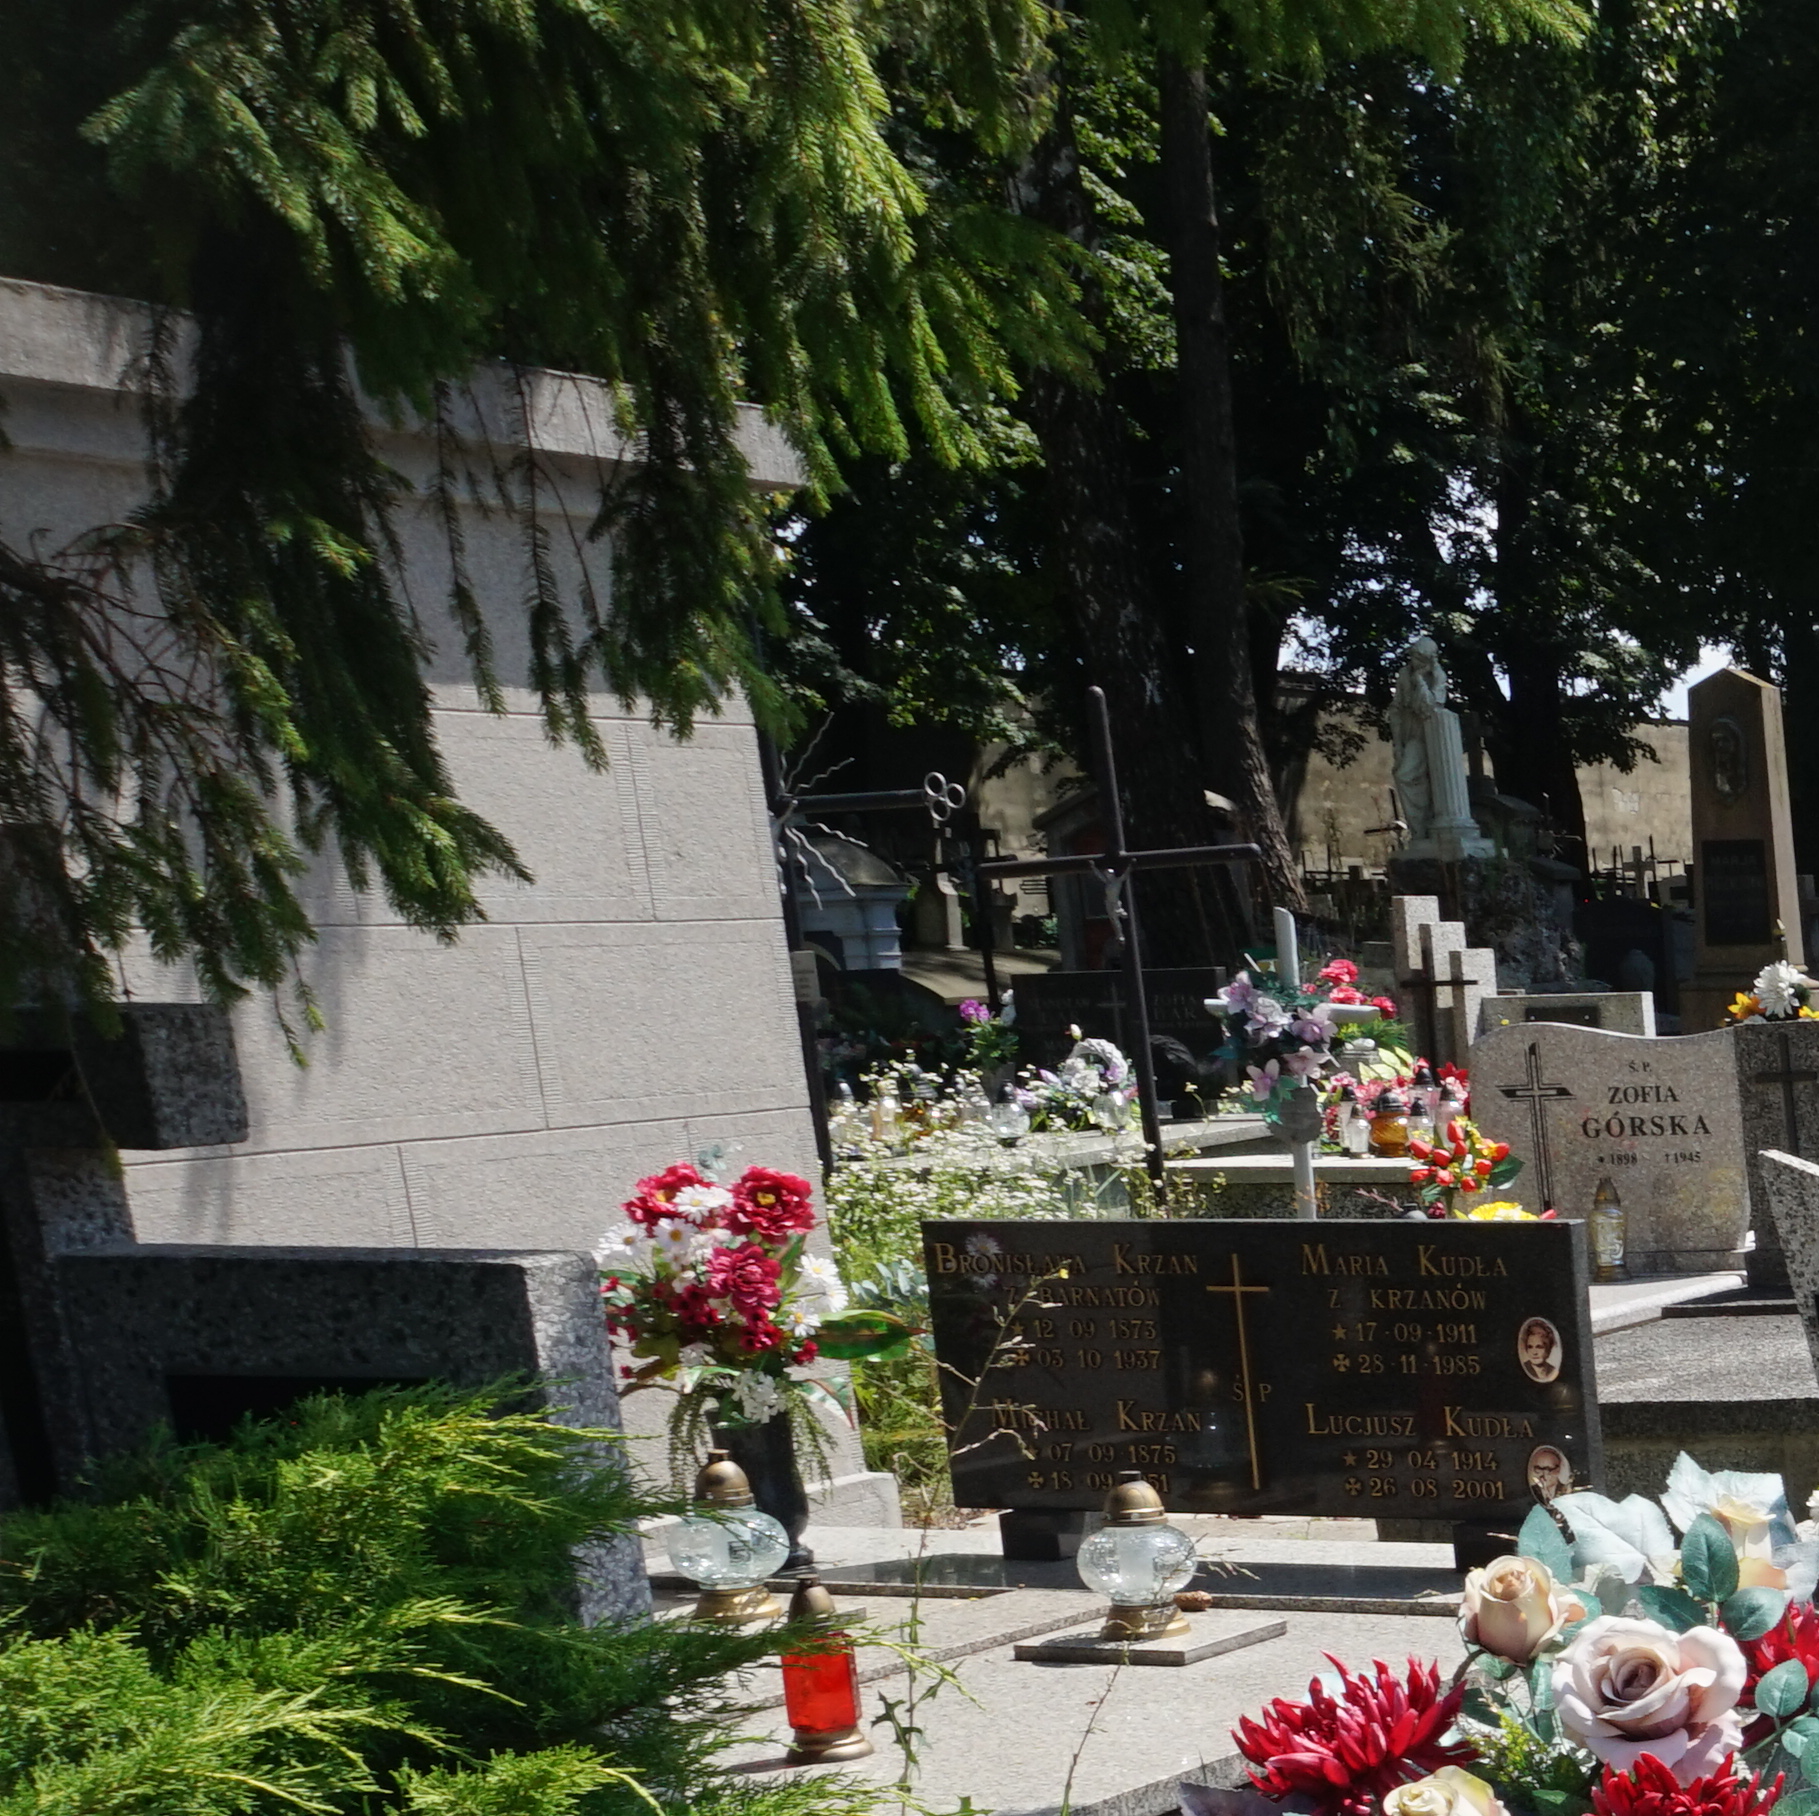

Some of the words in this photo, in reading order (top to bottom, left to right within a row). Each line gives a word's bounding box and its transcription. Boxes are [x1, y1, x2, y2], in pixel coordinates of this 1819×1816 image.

[1608, 1085, 1681, 1105] ZOFIA
[1582, 1108, 1712, 1139] GÓRSKA
[1609, 1151, 1638, 1167] 1898
[1673, 1151, 1702, 1165] 1945
[1039, 1279, 1162, 1308] BARNATÓW
[1327, 1288, 1342, 1309] Z
[1370, 1281, 1488, 1311] KRZANÓW
[1034, 1319, 1055, 1339] 12
[1069, 1319, 1096, 1339] 09
[1109, 1319, 1157, 1339] 1873
[1435, 1323, 1478, 1344] 1911
[1036, 1350, 1064, 1369] 03
[1078, 1350, 1102, 1369] 10
[1113, 1350, 1162, 1371] 1937
[1432, 1354, 1482, 1376] 1985
[1231, 1374, 1244, 1402] Ś
[1258, 1383, 1273, 1403] P
[1050, 1444, 1073, 1462] 07
[1088, 1444, 1115, 1462] 09
[1128, 1445, 1177, 1464] 1875
[1366, 1449, 1393, 1470] 29
[1406, 1450, 1437, 1470] 04
[1450, 1451, 1498, 1471] 1914
[1051, 1472, 1072, 1491] 18
[1086, 1473, 1114, 1491] 09
[1369, 1478, 1396, 1498] 26
[1410, 1479, 1439, 1499] 08
[1452, 1480, 1506, 1501] 2001
